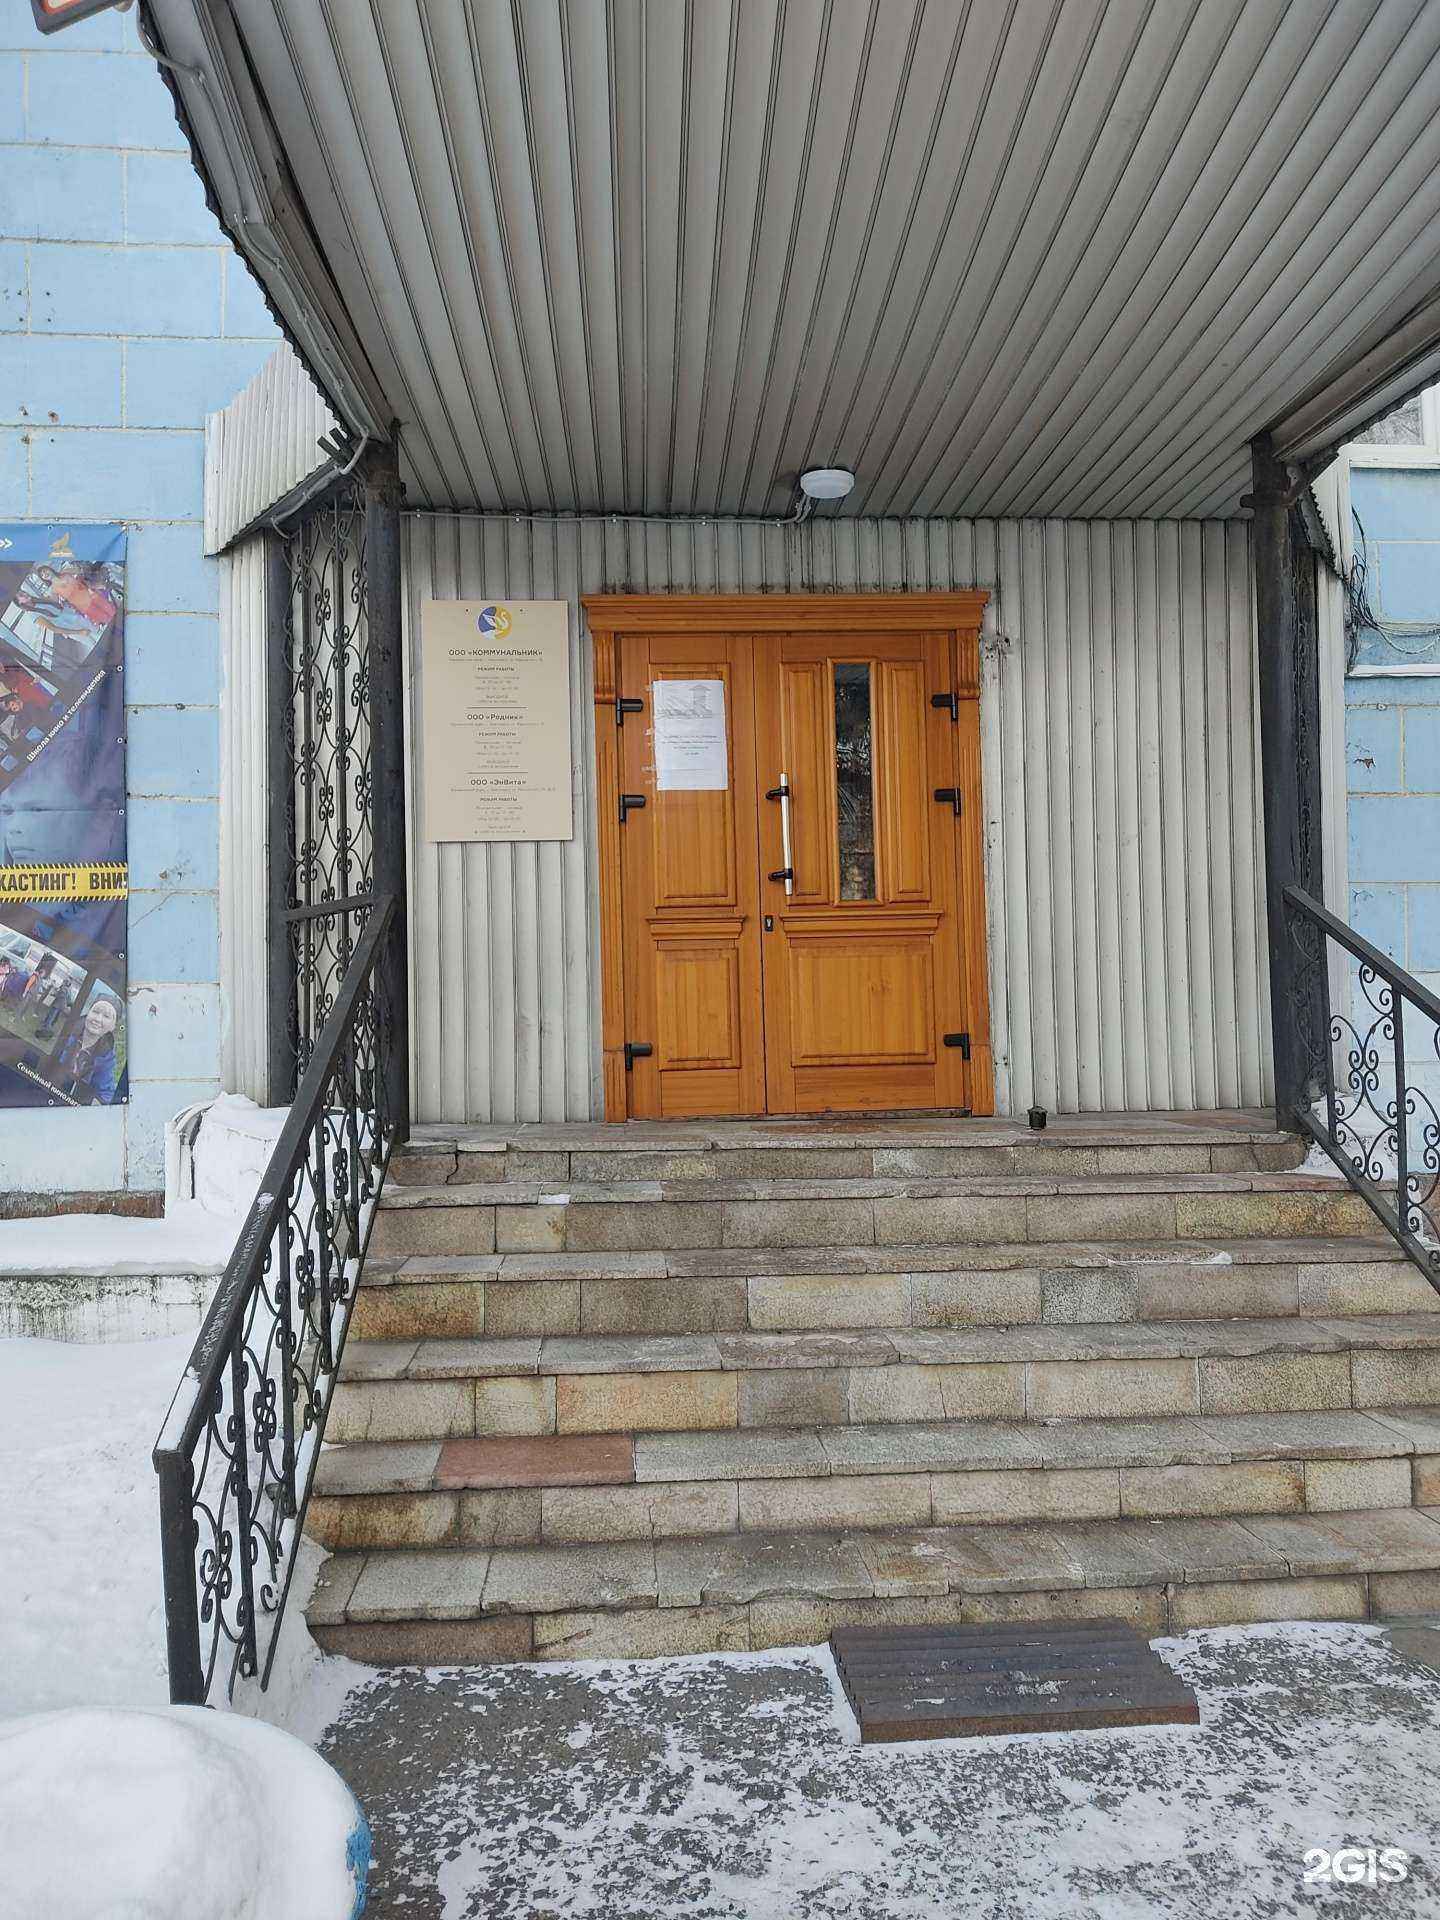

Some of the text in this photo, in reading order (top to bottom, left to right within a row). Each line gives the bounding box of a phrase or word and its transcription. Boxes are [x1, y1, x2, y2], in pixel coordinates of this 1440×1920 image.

[468, 648, 543, 656] «КОММУНАЛЬНИК»
[26, 736, 50, 762] Школа
[48, 720, 64, 739] кино
[67, 669, 106, 715] телевидения
[16, 1062, 51, 1090] Семейный
